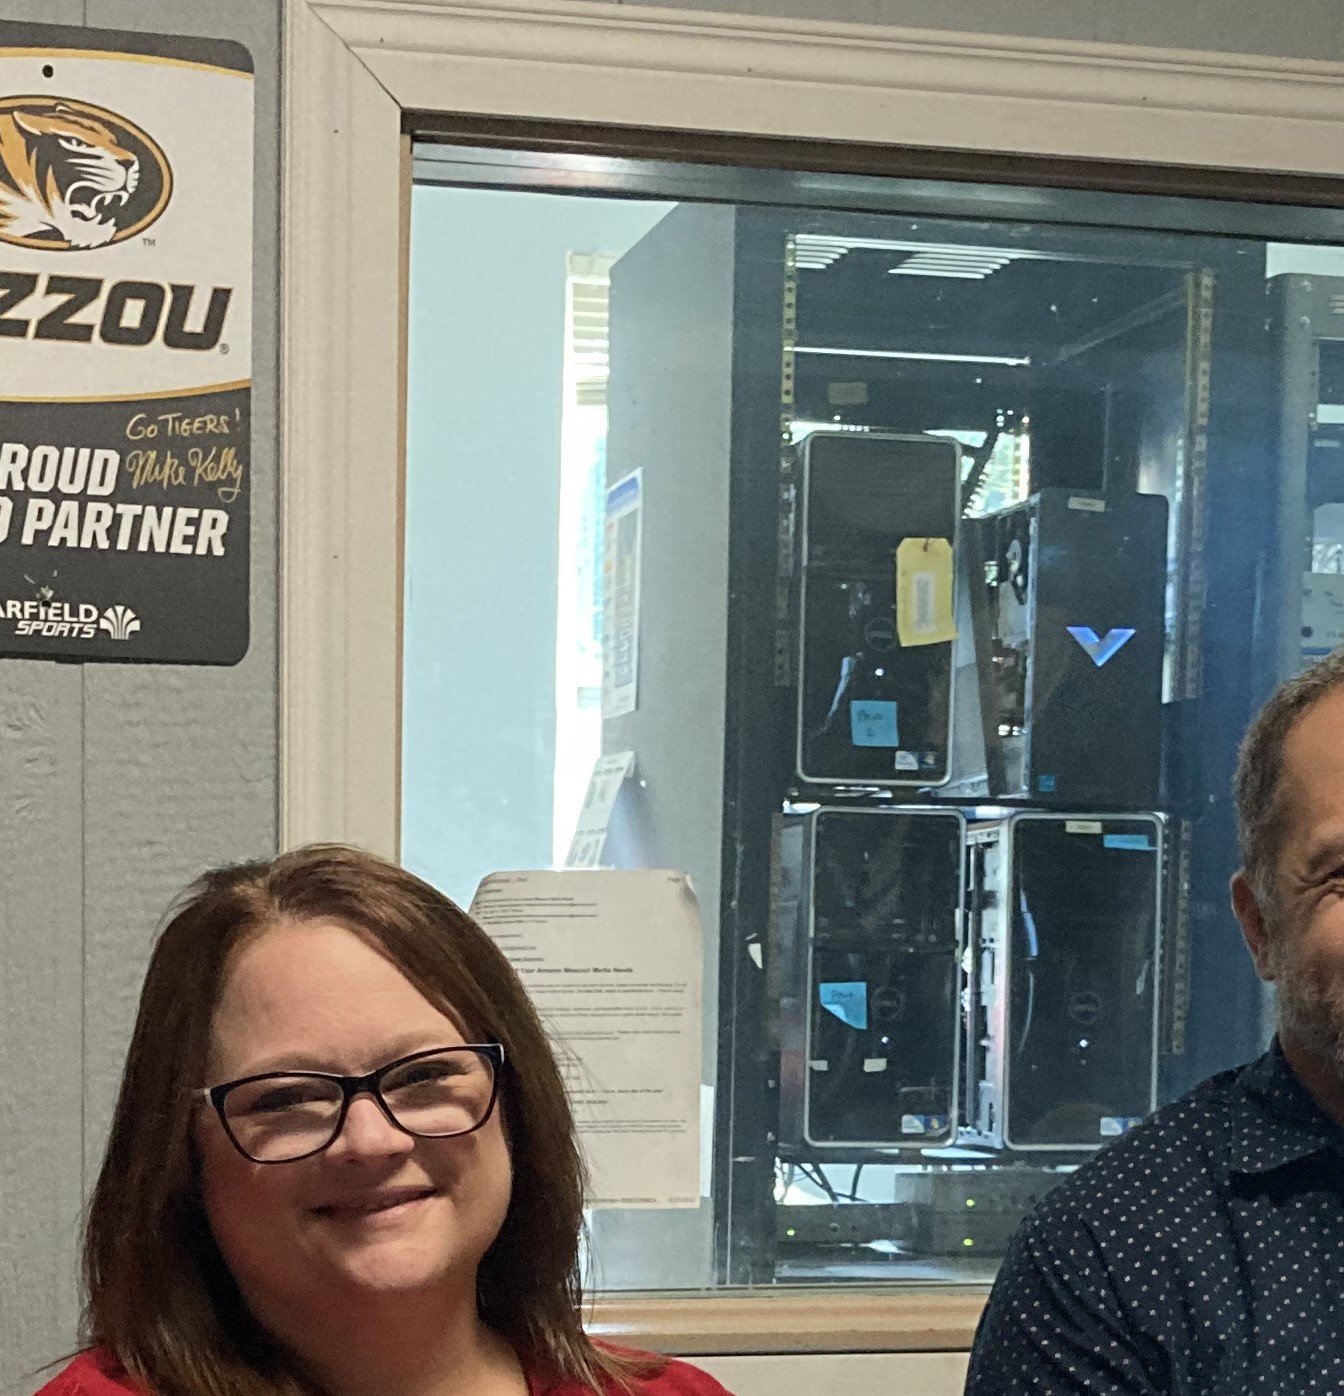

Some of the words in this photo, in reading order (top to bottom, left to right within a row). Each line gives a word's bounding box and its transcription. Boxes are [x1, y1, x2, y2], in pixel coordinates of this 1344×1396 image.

[125, 449, 187, 490] Mike
[187, 446, 244, 503] Kelly
[20, 498, 230, 556] PARTNER
[14, 620, 98, 638] SPORTS
